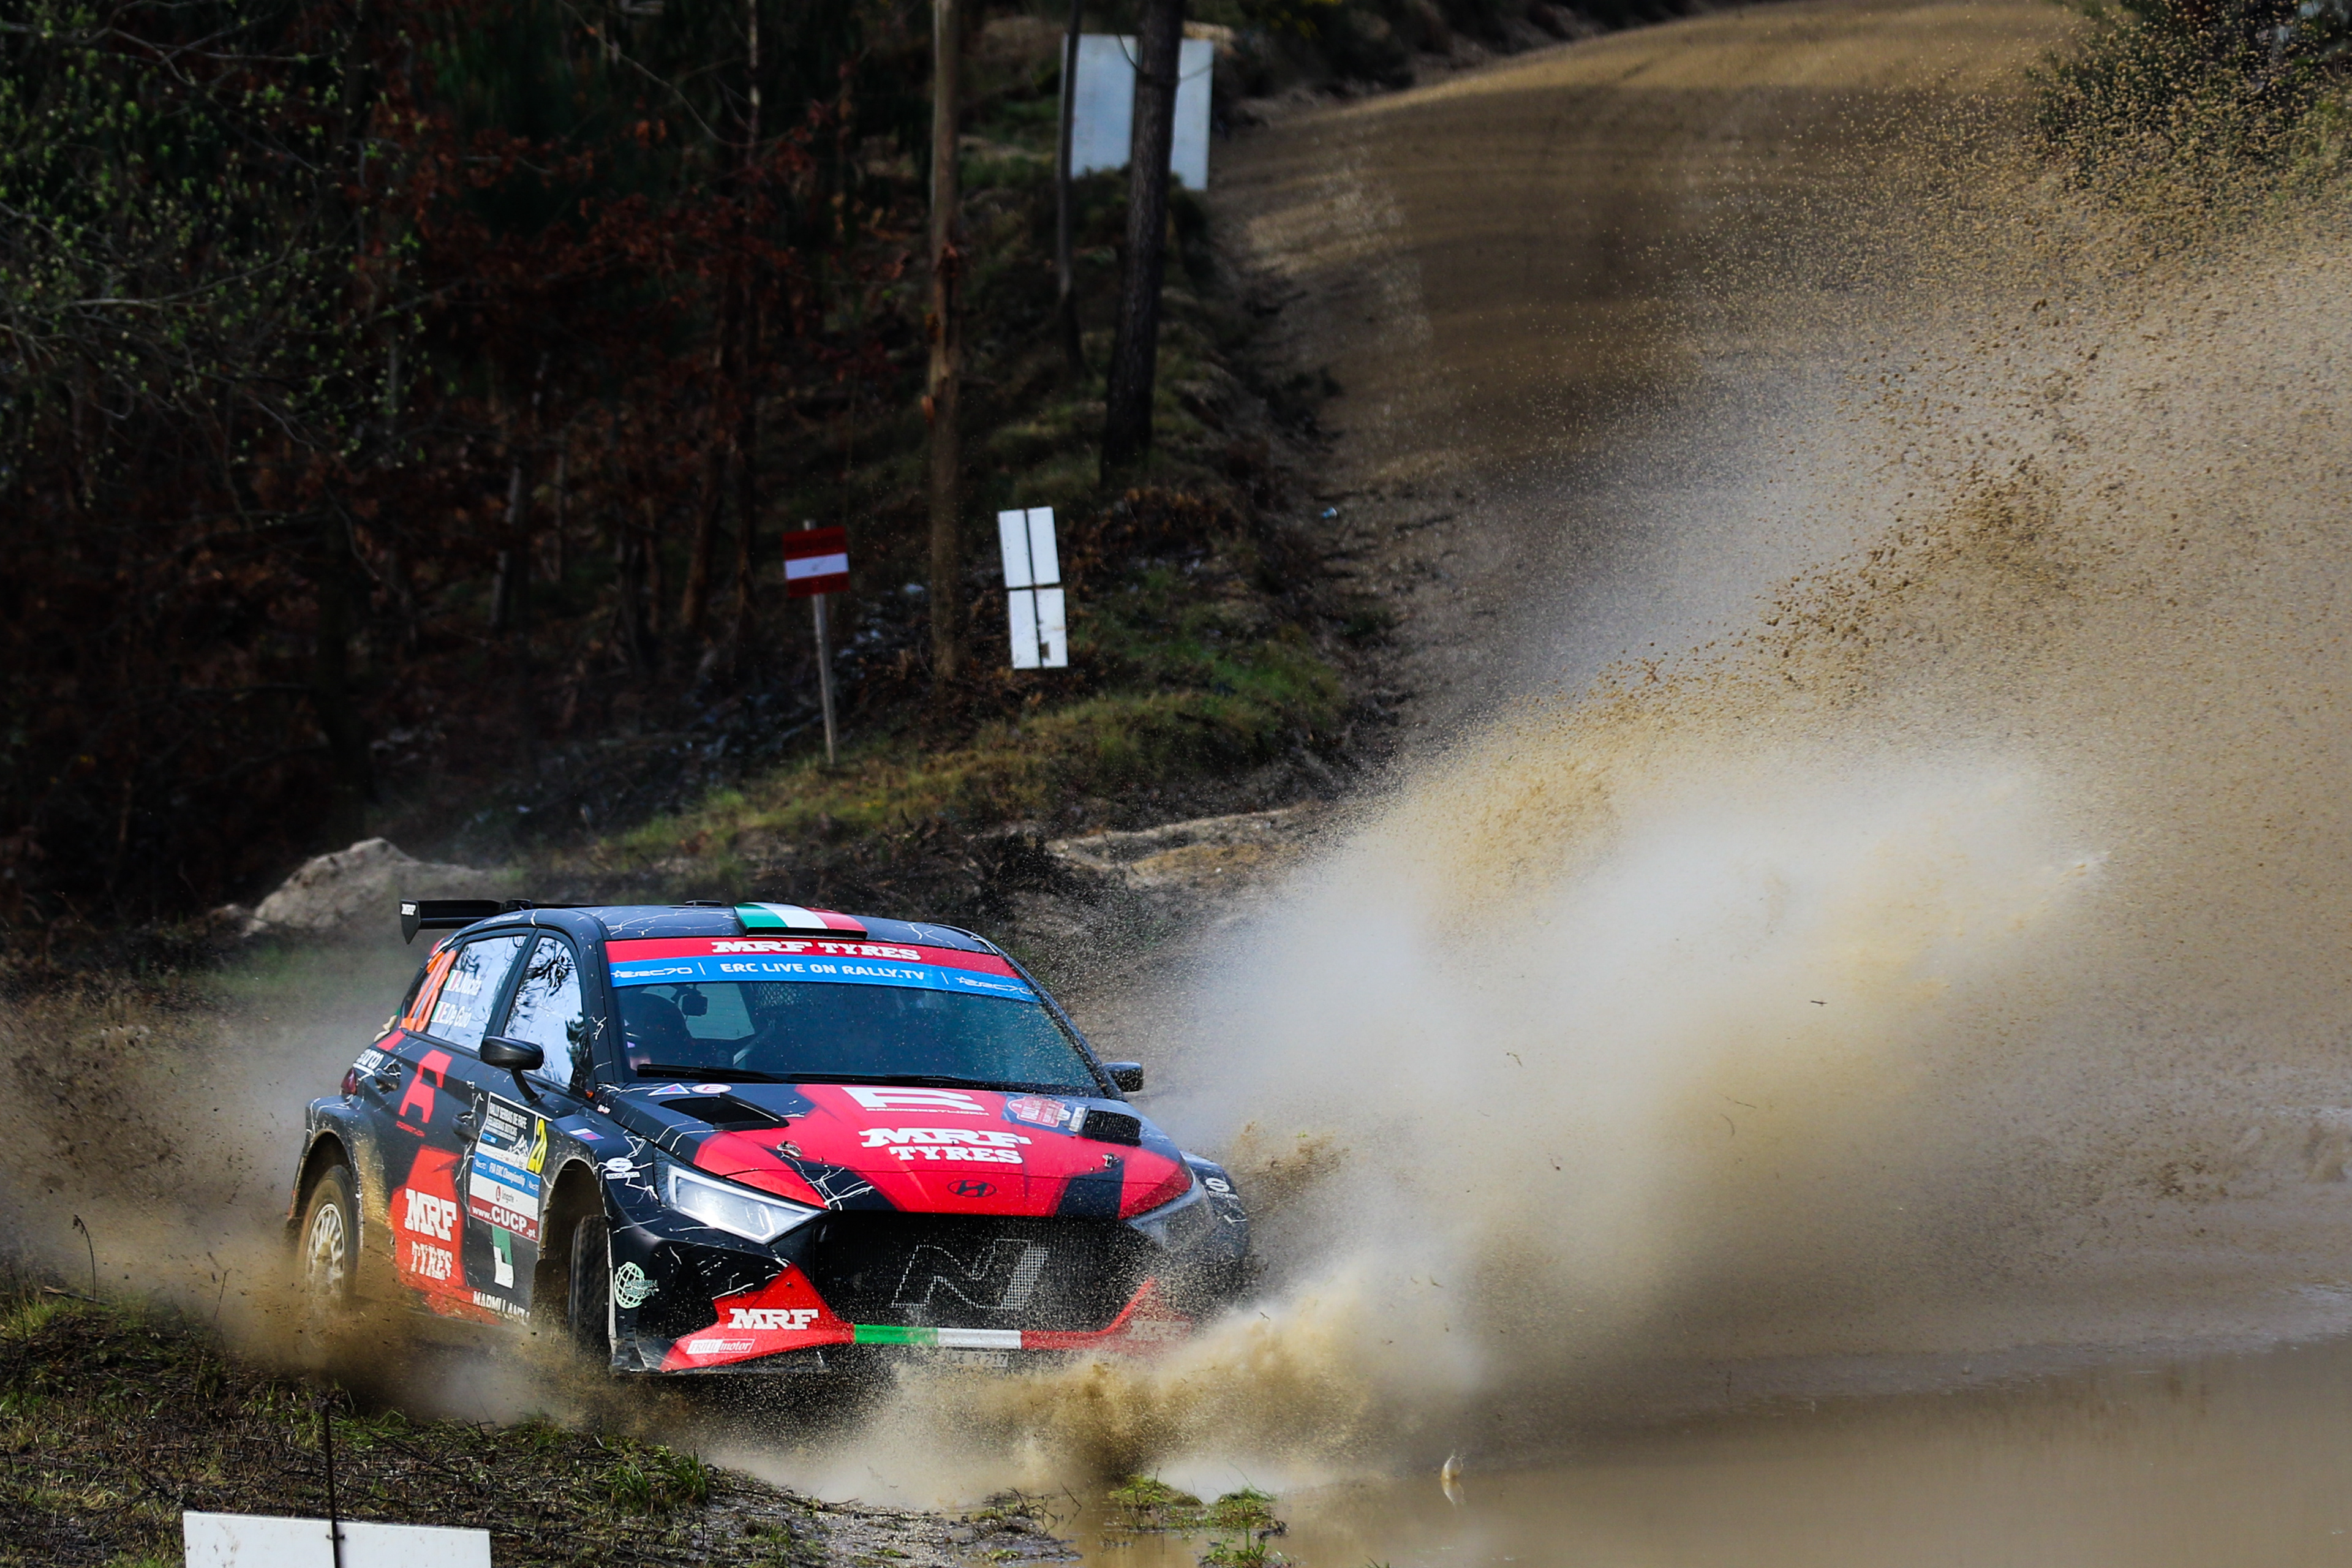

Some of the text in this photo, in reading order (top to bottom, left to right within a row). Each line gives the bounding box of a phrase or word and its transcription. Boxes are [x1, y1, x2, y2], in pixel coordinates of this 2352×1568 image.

[711, 941, 921, 960] MRF TYRES
[720, 963, 925, 980] ERC LIVE ON RALLY.TV
[858, 1128, 1033, 1148] MRF
[889, 1146, 1023, 1164] TYRES
[404, 1188, 458, 1242] MRF
[410, 1240, 453, 1281] TYRES
[727, 1308, 819, 1330] MRF
